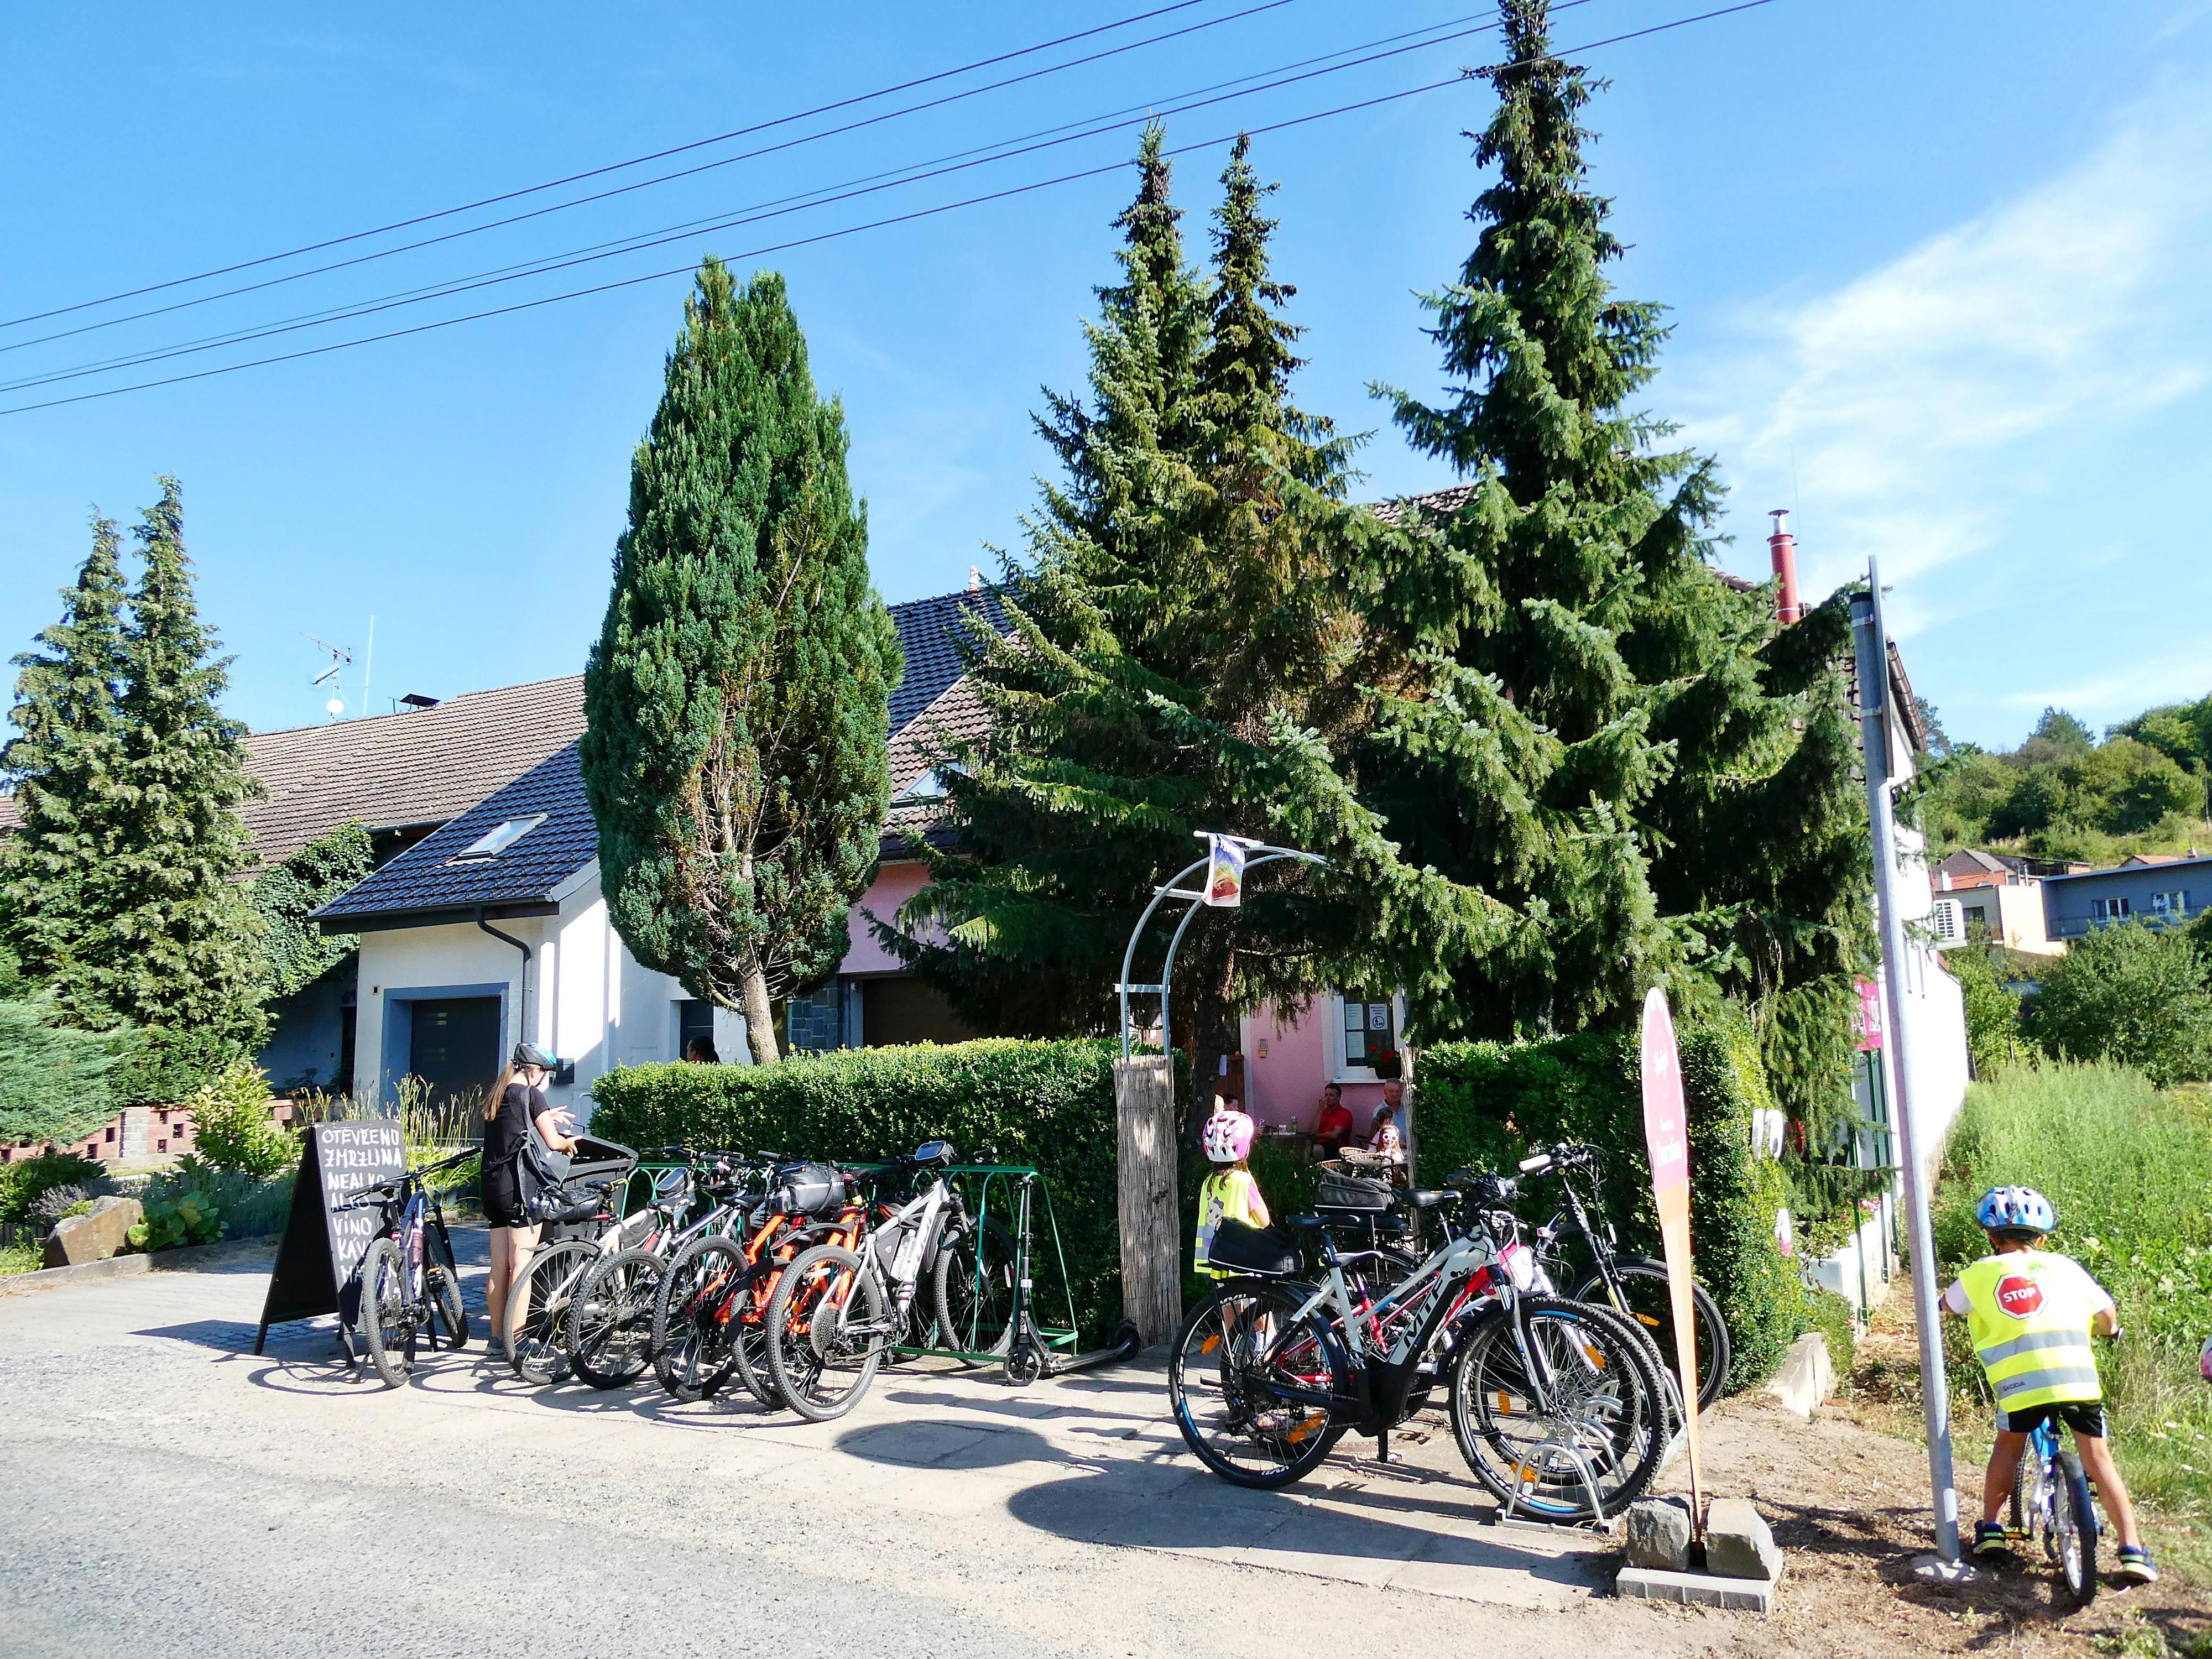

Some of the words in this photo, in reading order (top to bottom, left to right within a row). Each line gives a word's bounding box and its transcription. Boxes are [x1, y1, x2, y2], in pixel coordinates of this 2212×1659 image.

[324, 1147, 403, 1168] ZMRZLINA
[337, 1237, 372, 1261] KÁV
[2002, 1287, 2036, 1303] STOP
